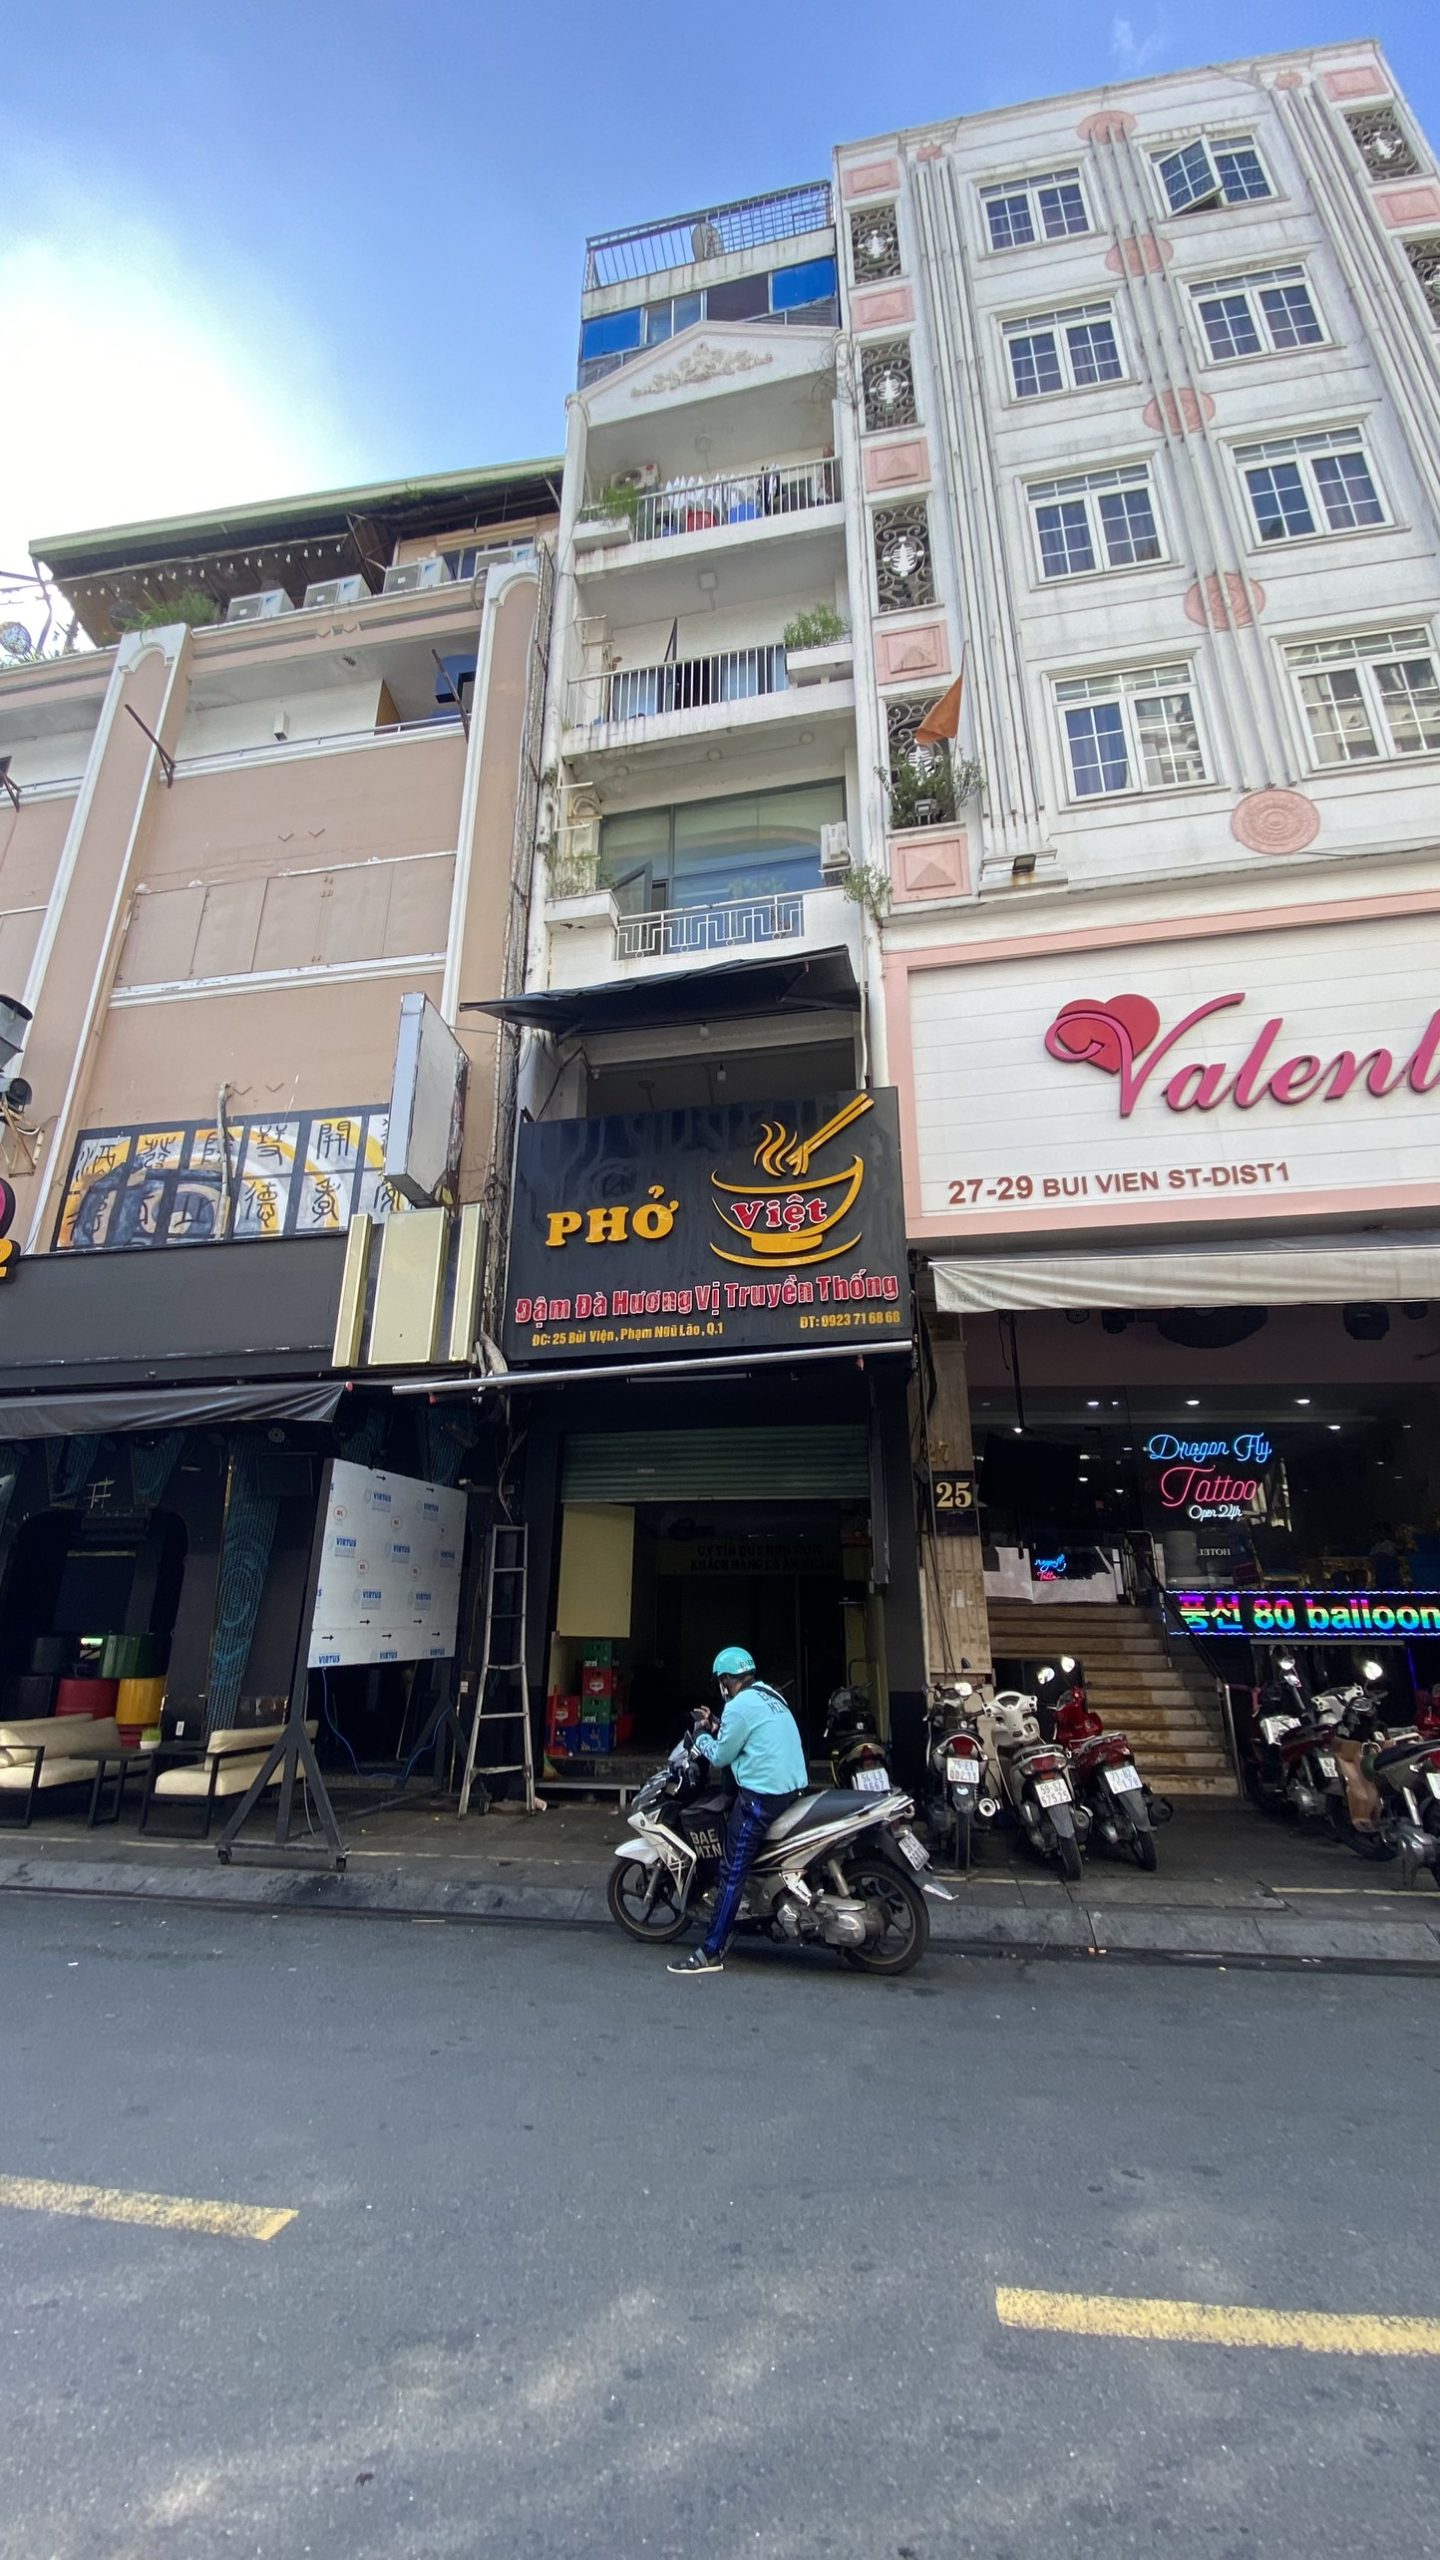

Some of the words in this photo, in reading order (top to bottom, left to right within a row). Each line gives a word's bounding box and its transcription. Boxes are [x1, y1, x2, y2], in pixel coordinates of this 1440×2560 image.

[949, 1175, 1033, 1205] 27-29
[1043, 1176, 1088, 1198] BUI
[1095, 1171, 1159, 1194] VIEN
[545, 1185, 679, 1247] PHỞ
[730, 1193, 828, 1232] Việt
[515, 1296, 571, 1328] Đậm
[575, 1292, 608, 1319] Đà
[612, 1289, 693, 1316] Hương
[694, 1281, 720, 1315] Vị
[724, 1274, 814, 1308] Truyền
[816, 1269, 899, 1301] Thống
[821, 1313, 852, 1327] 0923
[853, 1312, 867, 1325] 71
[552, 1332, 567, 1345] 25
[569, 1330, 587, 1344] Bùi
[620, 1327, 652, 1341] Phạm
[706, 1322, 724, 1336] Q.1
[1149, 1434, 1230, 1463] Dragon
[1233, 1432, 1272, 1463] Fly
[936, 1482, 972, 1508] 25
[1161, 1465, 1257, 1507] Tattoo
[1189, 1504, 1218, 1522] Open
[336, 1537, 357, 1548] VIRTUS
[362, 1591, 382, 1600] VIRTUS
[1179, 1596, 1243, 1631] 풍선
[1253, 1599, 1296, 1630] 80
[318, 1654, 340, 1664] VIRTUS
[690, 1828, 719, 1845] BAE
[694, 1842, 722, 1859] MIN
